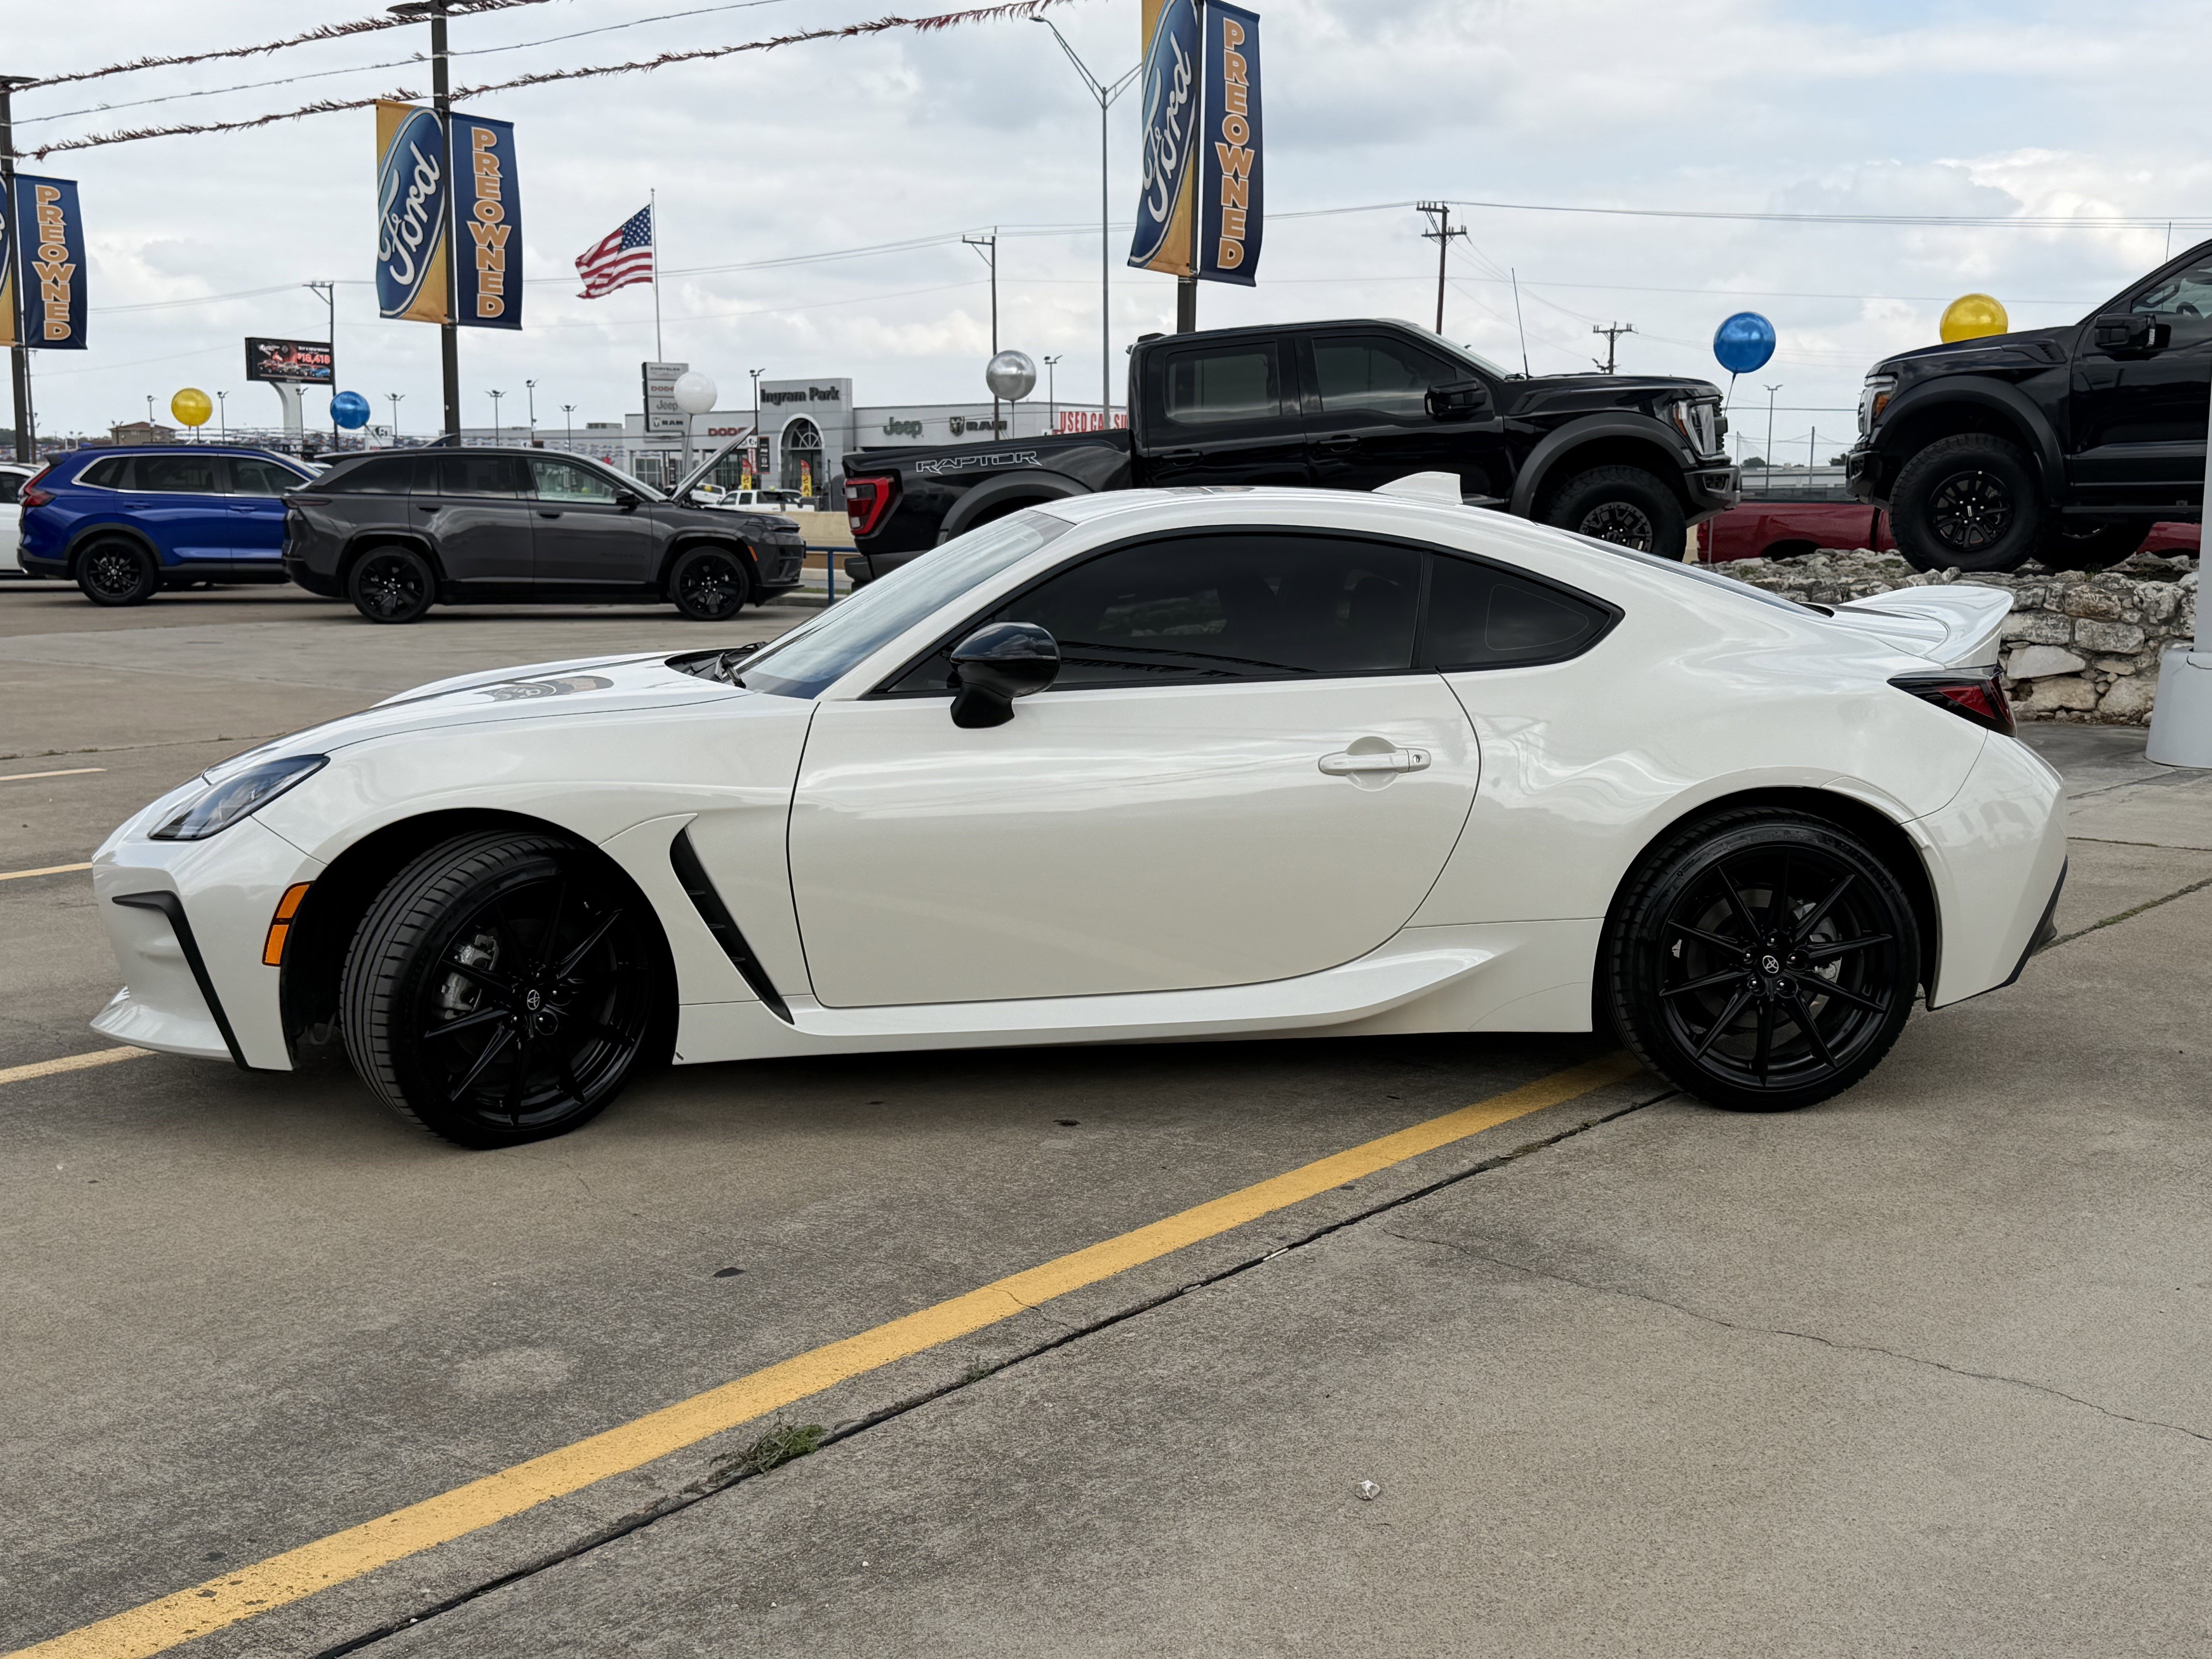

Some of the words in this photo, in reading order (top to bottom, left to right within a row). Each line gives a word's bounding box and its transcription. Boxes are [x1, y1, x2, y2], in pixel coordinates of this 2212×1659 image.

[1143, 31, 1192, 223] Ford
[1215, 17, 1255, 270] PREOWNED
[378, 141, 441, 285] Ford
[466, 127, 512, 318] PREOWNED
[32, 184, 76, 341] PREOWNED
[656, 399, 678, 411] Jeep
[761, 389, 806, 406] Ingram
[809, 386, 840, 401] Park
[883, 417, 923, 439] Jeep
[966, 420, 1007, 431] RAM
[1060, 411, 1087, 433] USED
[1091, 413, 1104, 431] CA
[916, 451, 1043, 475] RAPTOR
